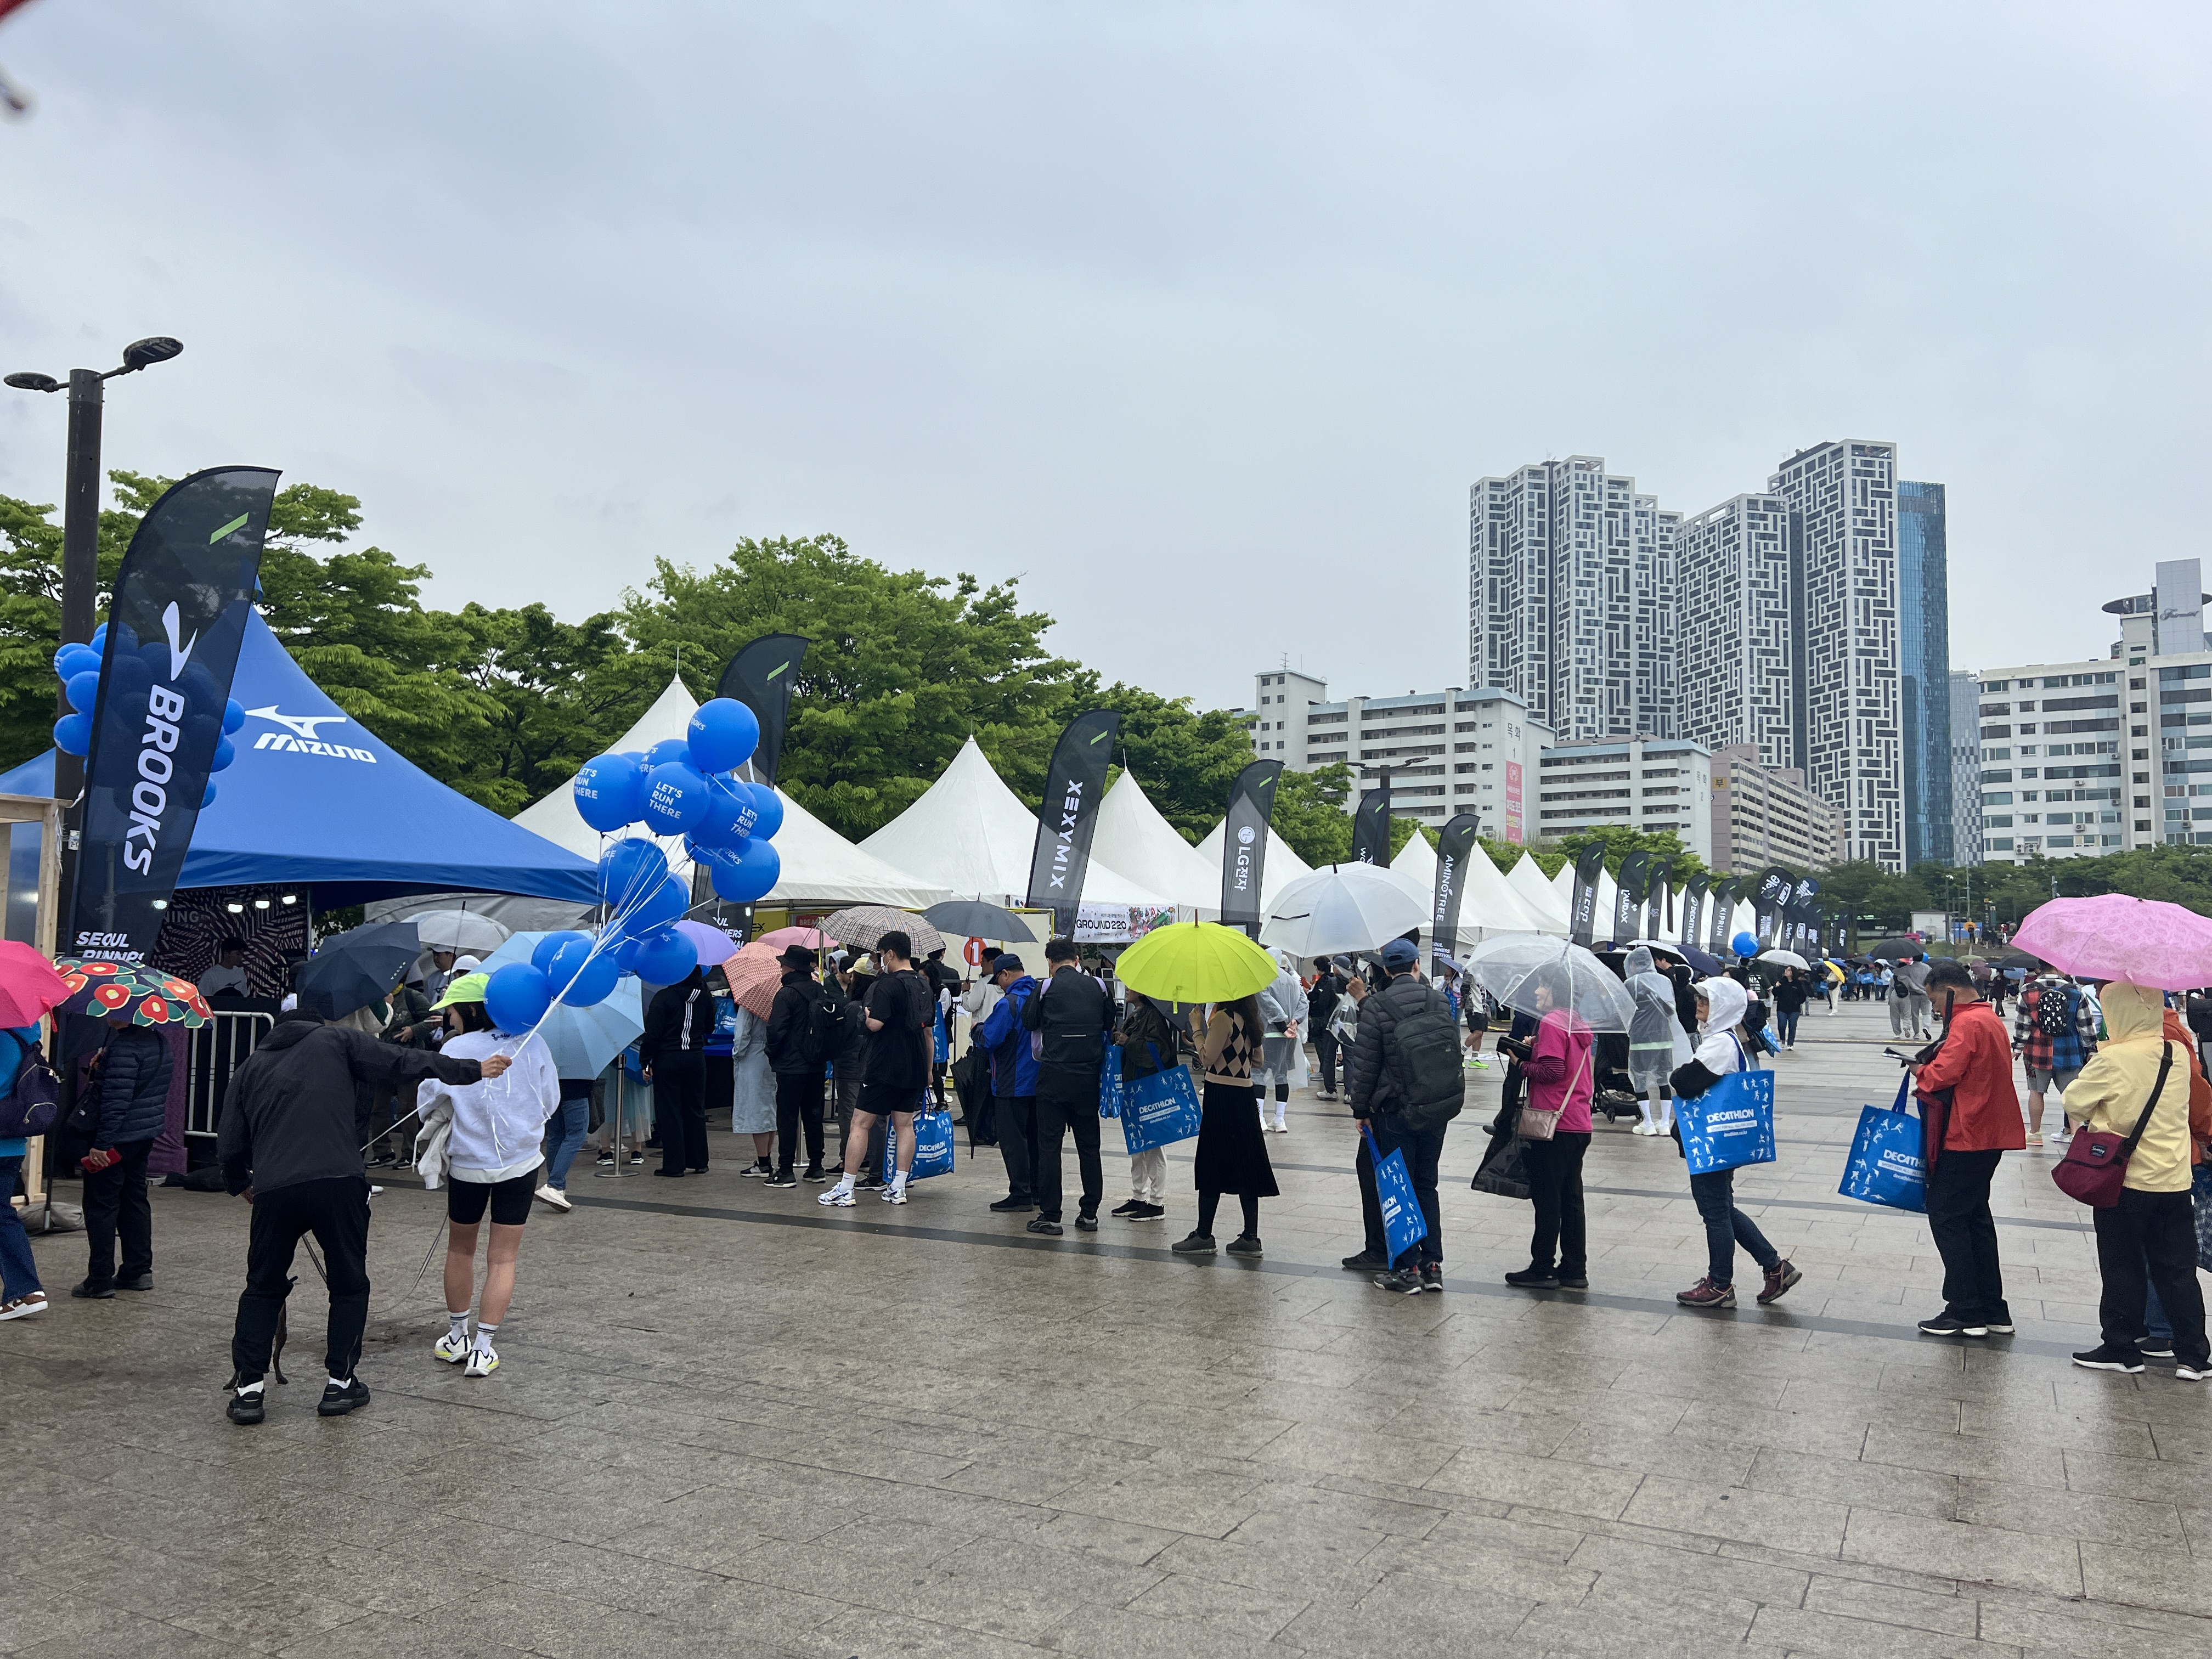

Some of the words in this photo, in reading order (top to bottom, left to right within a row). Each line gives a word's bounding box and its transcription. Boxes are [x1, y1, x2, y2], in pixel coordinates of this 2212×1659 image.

[690, 717, 706, 731] OOKS
[1508, 723, 1521, 741] 목화
[123, 684, 185, 876] BROOKS
[575, 776, 589, 786] RUN
[579, 768, 597, 777] LET'S
[656, 781, 683, 798] LET'S
[1715, 778, 1724, 788] 부
[574, 786, 598, 799] THERE
[651, 790, 674, 806] RUN
[649, 799, 682, 819] THERE
[741, 806, 758, 821] LET'S
[737, 815, 754, 830] RUN
[1049, 779, 1083, 889] XEXYMIX
[1234, 846, 1251, 891] LG전자
[1436, 854, 1454, 922] AMINOTREE
[1686, 906, 1697, 945] DECATHLON
[1716, 907, 1728, 936] KIPRUN
[76, 932, 129, 947] SEOUL
[969, 941, 979, 963] 1
[1138, 1097, 1176, 1114] DECATHLON
[1706, 1108, 1754, 1123] DECATHLON
[887, 1126, 897, 1179] DECATHLO
[918, 1140, 945, 1152] DECATHLON
